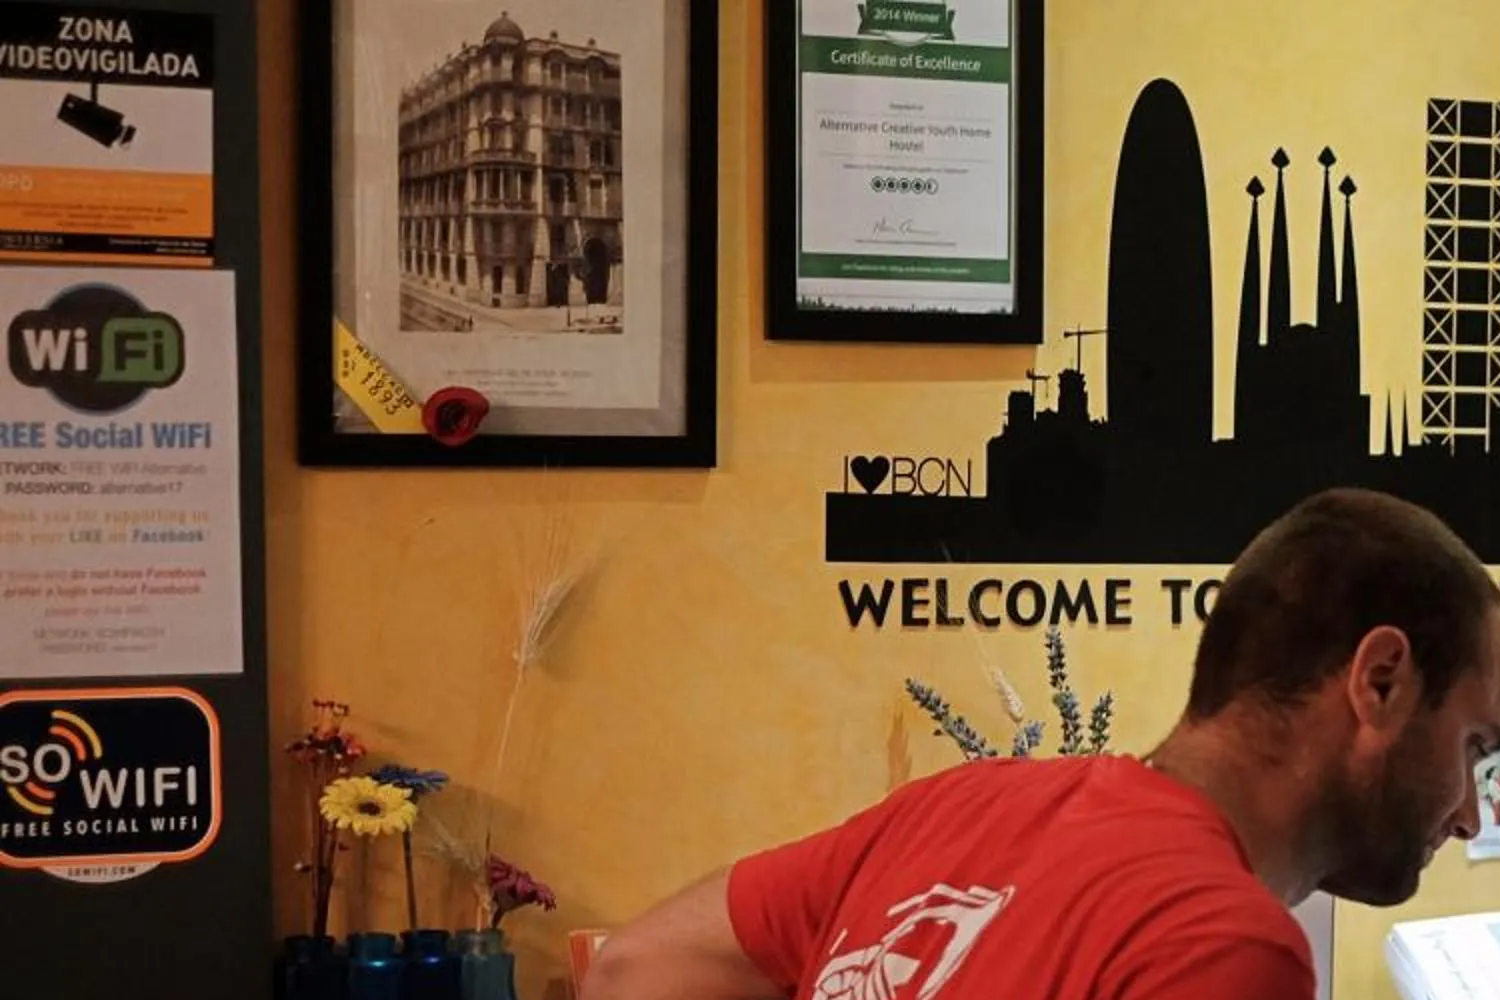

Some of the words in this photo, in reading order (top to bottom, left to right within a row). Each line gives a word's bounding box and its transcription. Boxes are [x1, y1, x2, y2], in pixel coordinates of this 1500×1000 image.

[58, 17, 133, 43] ZONA
[831, 50, 896, 68] Certificate
[900, 54, 913, 68] of
[915, 55, 981, 73] Excellence
[359, 371, 401, 416] 1893
[55, 422, 142, 449] Social
[0, 461, 68, 475] TWORK:
[891, 456, 972, 497] BCN
[838, 579, 1132, 627] WELCOME
[0, 744, 70, 783] SO
[79, 765, 198, 809] WIFI
[1, 821, 51, 838] FREE
[63, 817, 140, 836] SOCIAL
[150, 815, 198, 832] WIFI
